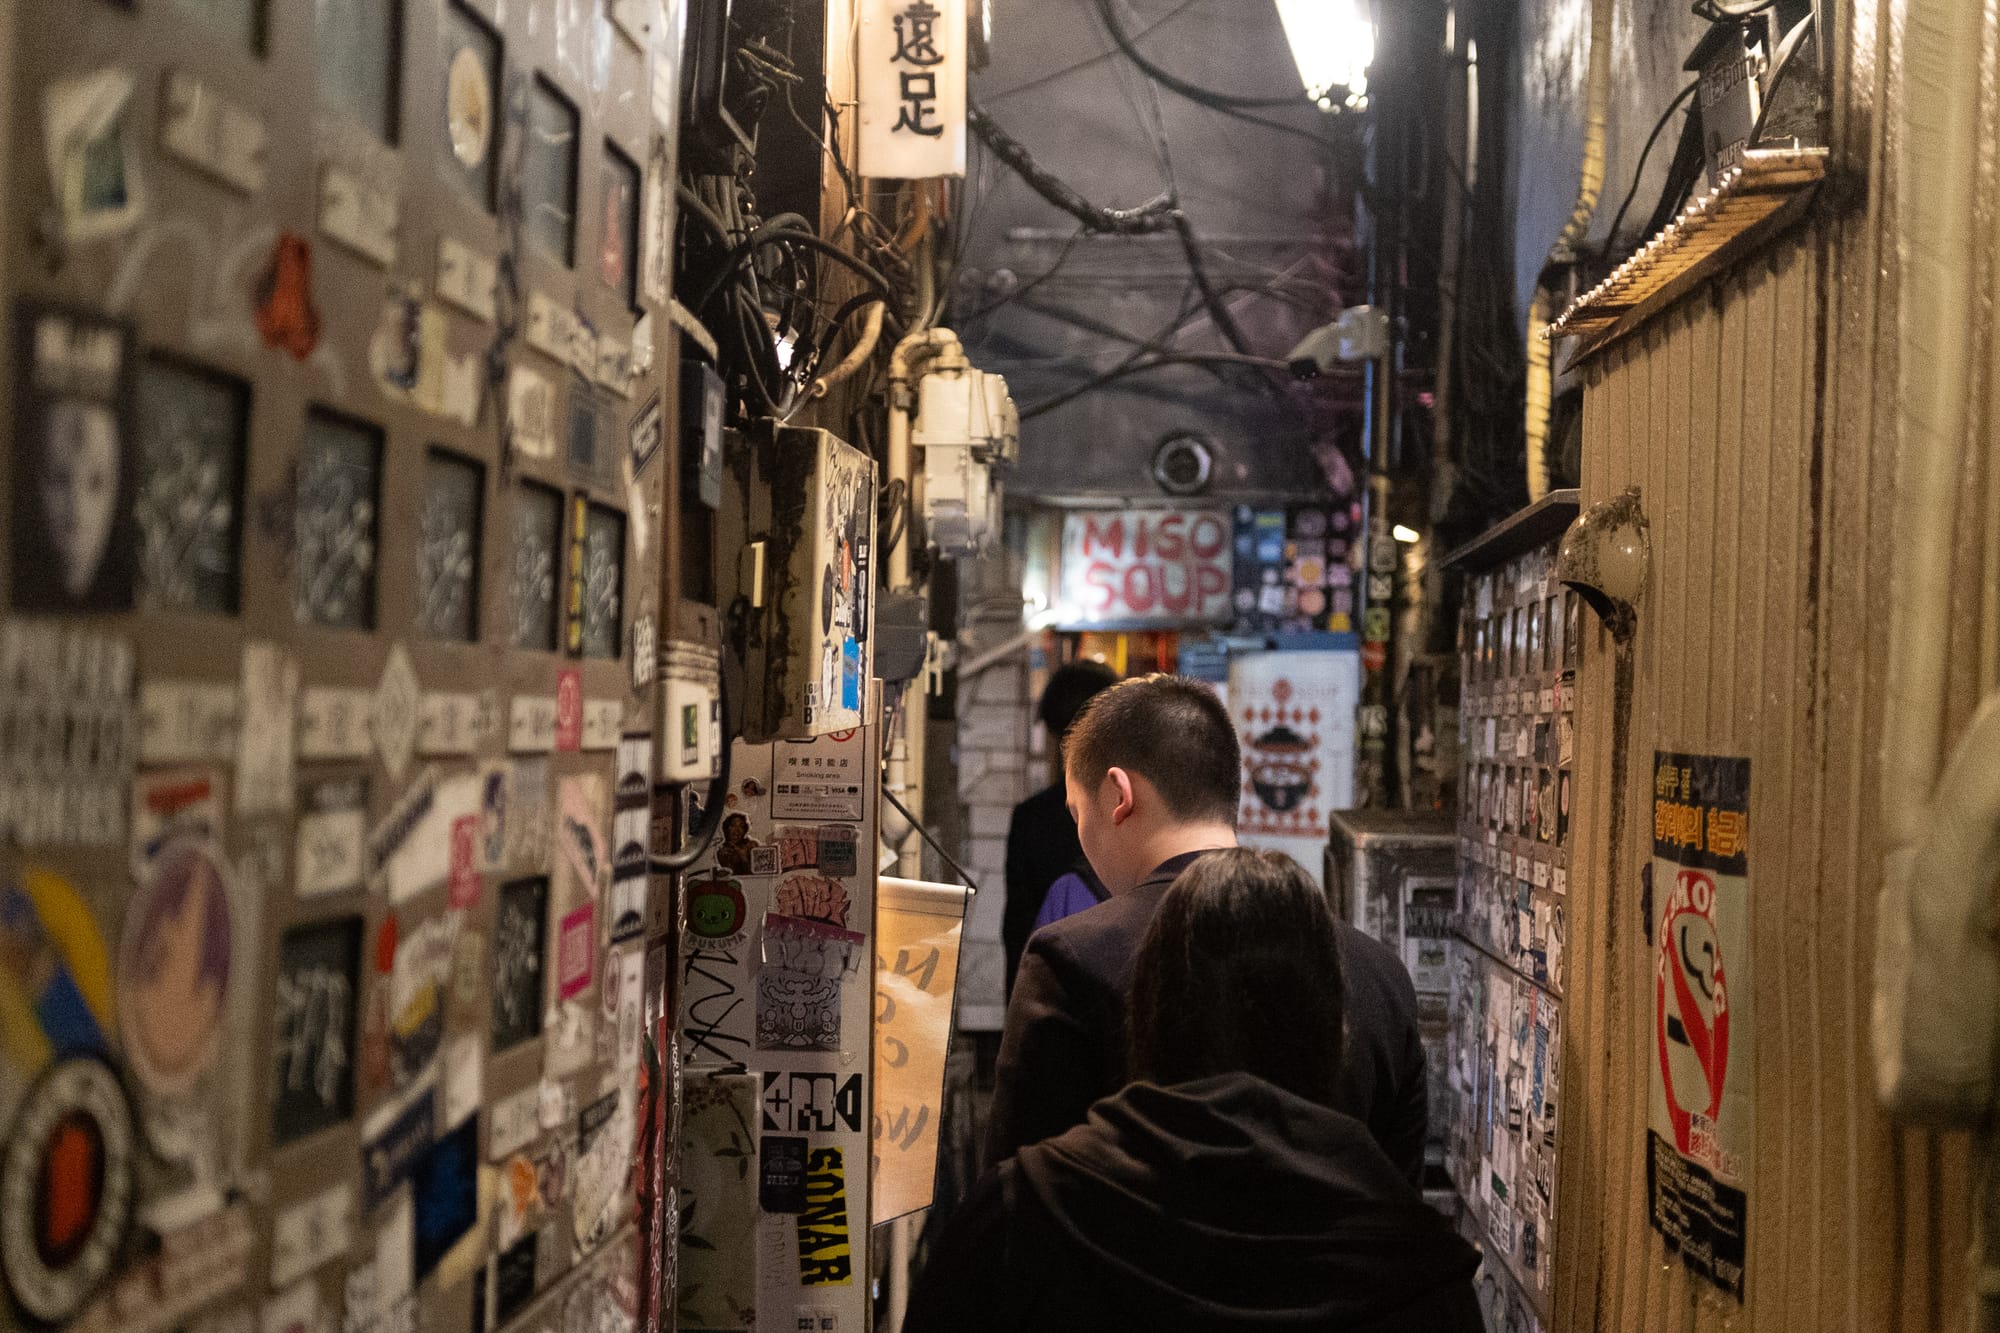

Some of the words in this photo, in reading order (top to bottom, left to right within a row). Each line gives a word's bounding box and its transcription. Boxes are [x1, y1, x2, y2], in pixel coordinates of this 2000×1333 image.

[1082, 512, 1225, 560] MISO
[1085, 560, 1227, 614] SOUP
[797, 1147, 852, 1285] SONAR
